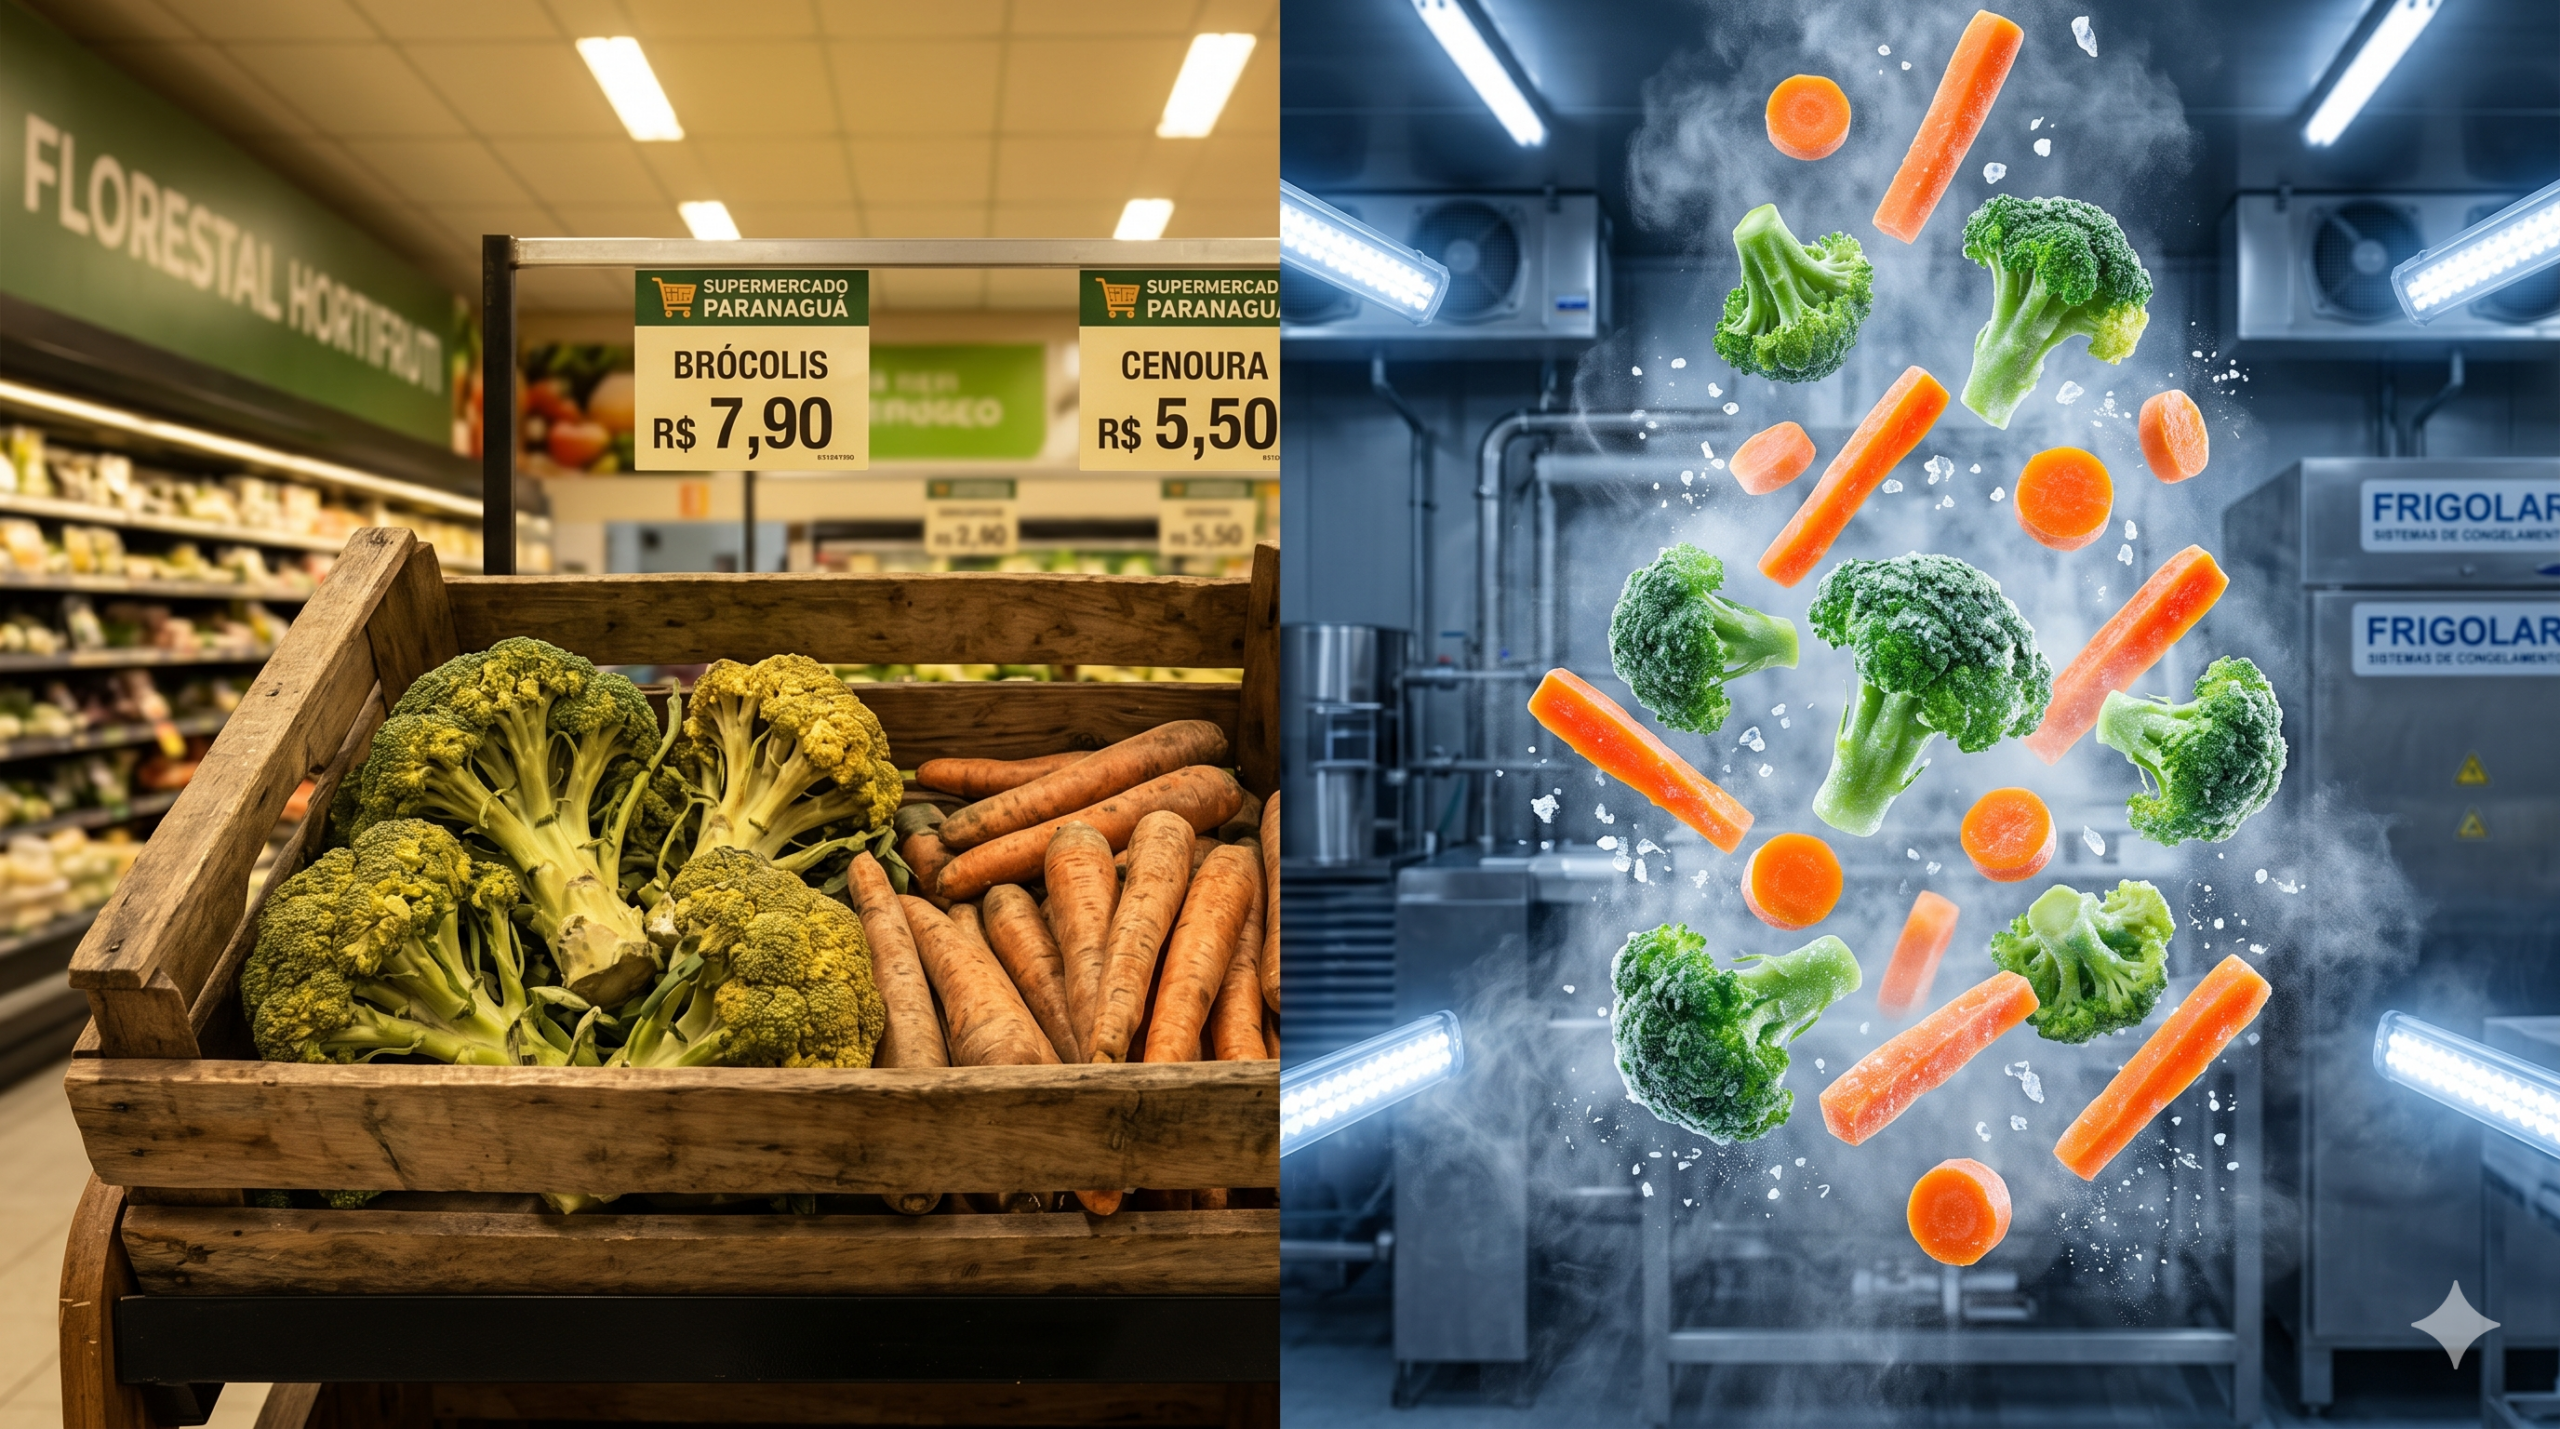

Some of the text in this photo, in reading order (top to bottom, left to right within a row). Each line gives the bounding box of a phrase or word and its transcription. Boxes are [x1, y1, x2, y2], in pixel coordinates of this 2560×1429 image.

[23, 112, 443, 396] FLORESTAL HORTIFRUTI
[703, 279, 849, 294] SUPERMERCADO
[703, 294, 849, 318] PARANAGUÁ
[674, 343, 829, 380] BRÓCOLIS
[1121, 350, 1269, 380] CENOURA
[653, 415, 697, 453] R$
[710, 396, 833, 460] 7,90
[1098, 397, 1278, 460] R$ 5,50
[2373, 528, 2438, 542] SISTEMAS
[2440, 528, 2459, 542] DE
[2367, 616, 2560, 646] FRIGOLAR
[2368, 652, 2432, 666] SISTEMAS
[2435, 652, 2454, 666] DE
